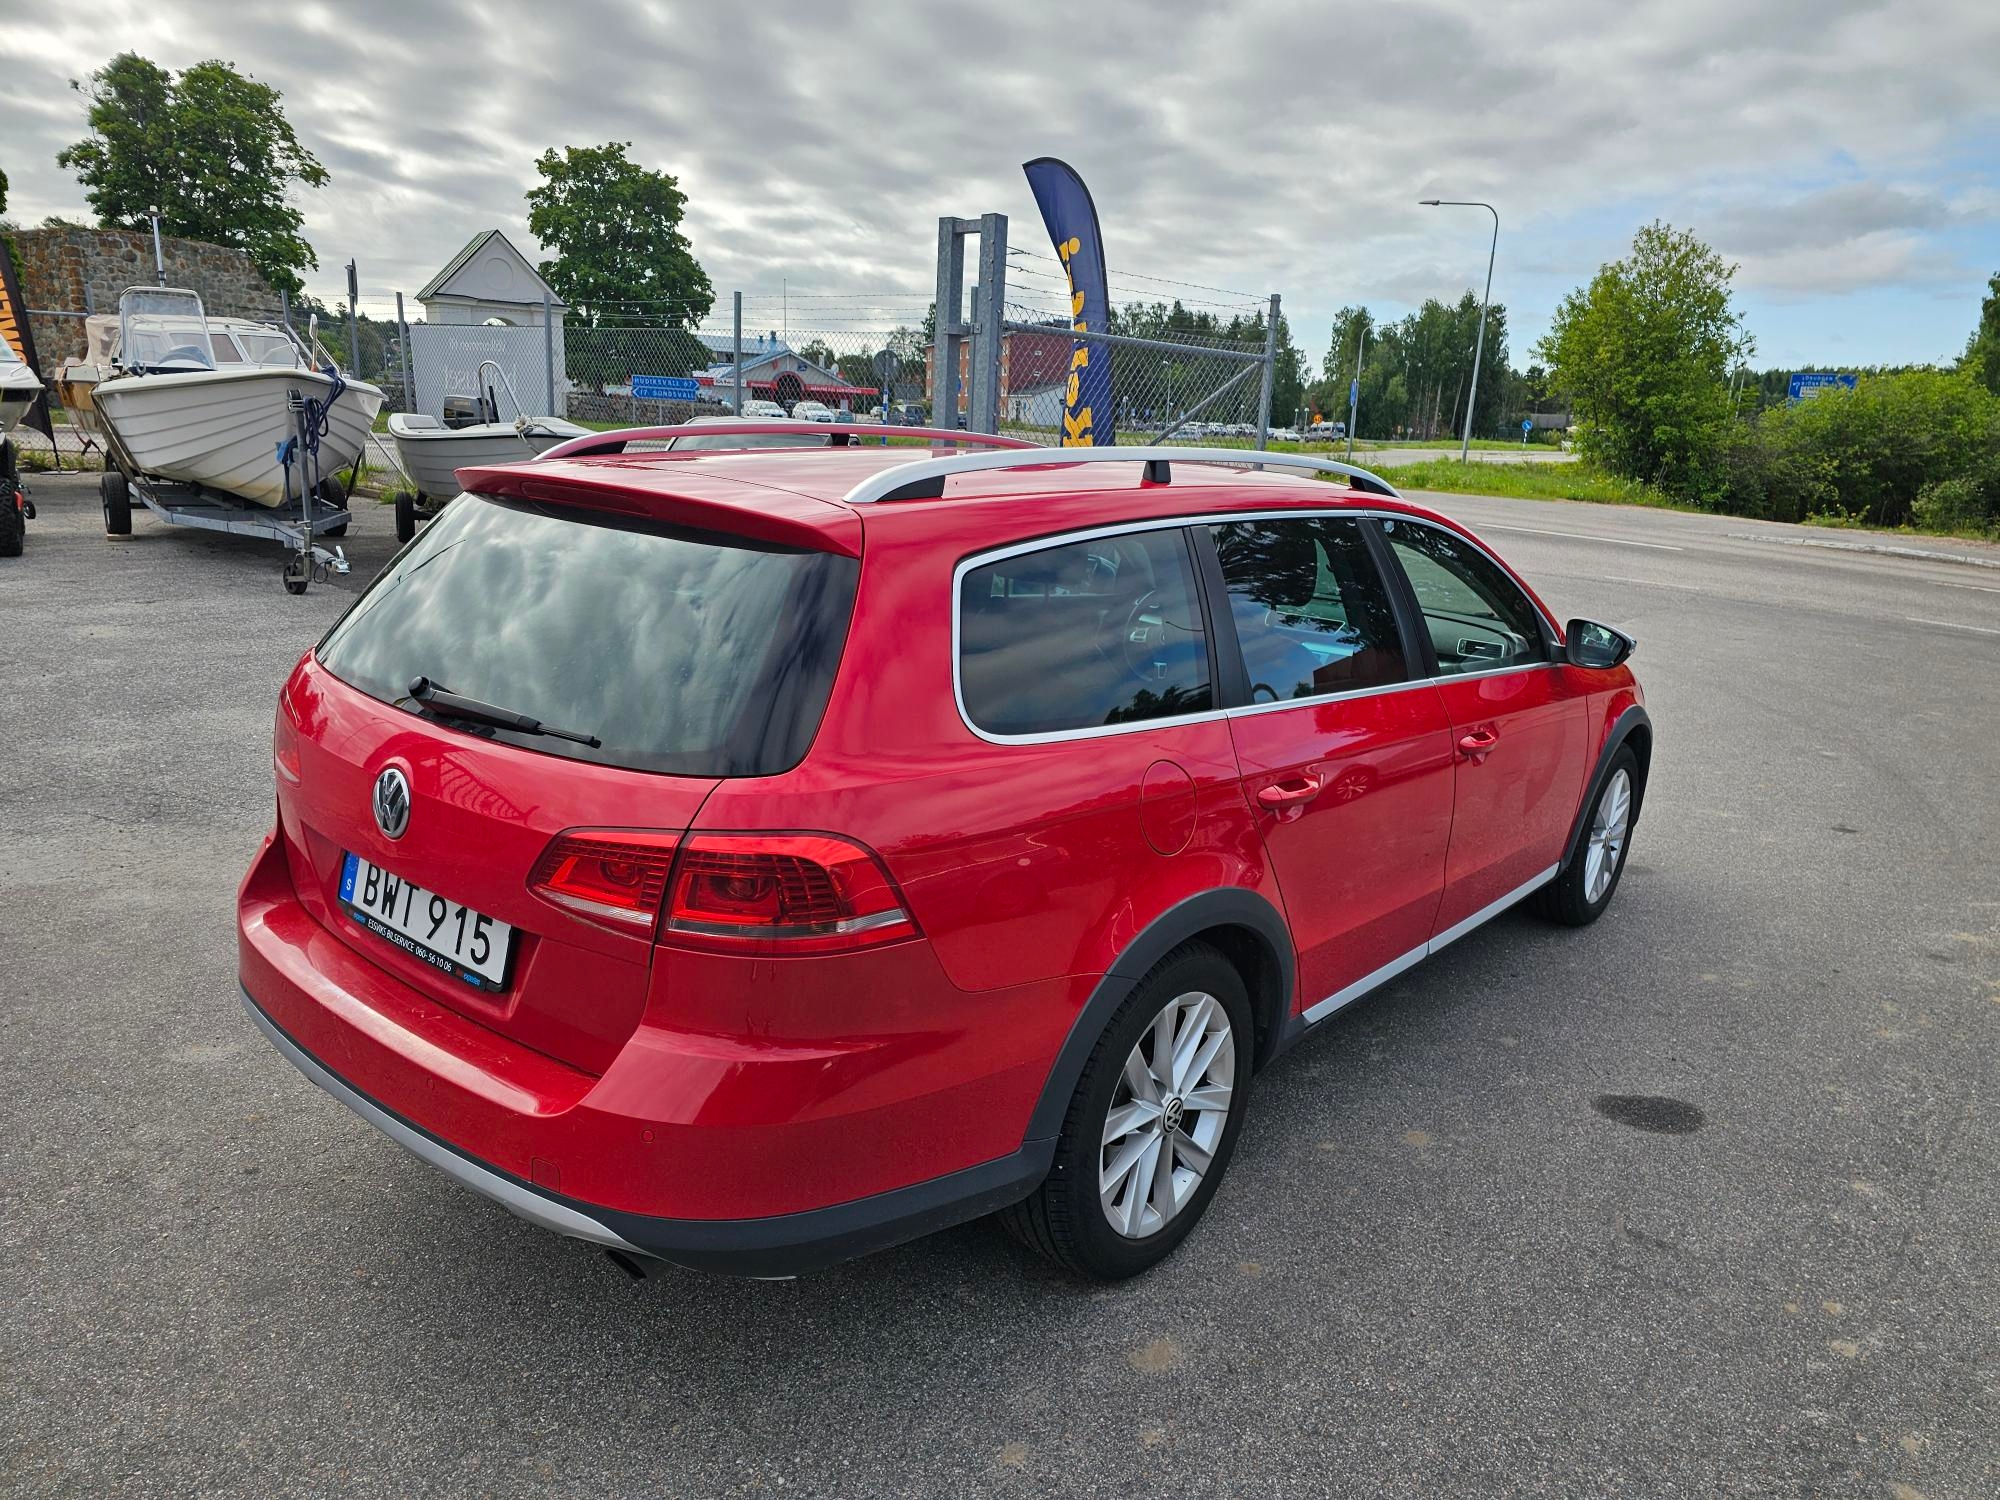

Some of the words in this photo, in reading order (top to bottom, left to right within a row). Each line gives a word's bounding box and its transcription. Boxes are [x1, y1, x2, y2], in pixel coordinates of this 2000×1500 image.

[634, 377, 680, 386] HUDIKSVALL
[346, 878, 352, 891] S
[363, 863, 420, 928] BWT
[427, 895, 493, 965] 915
[386, 929, 415, 953] BILSERVICE
[428, 953, 436, 964] 56
[436, 957, 444, 968] 10
